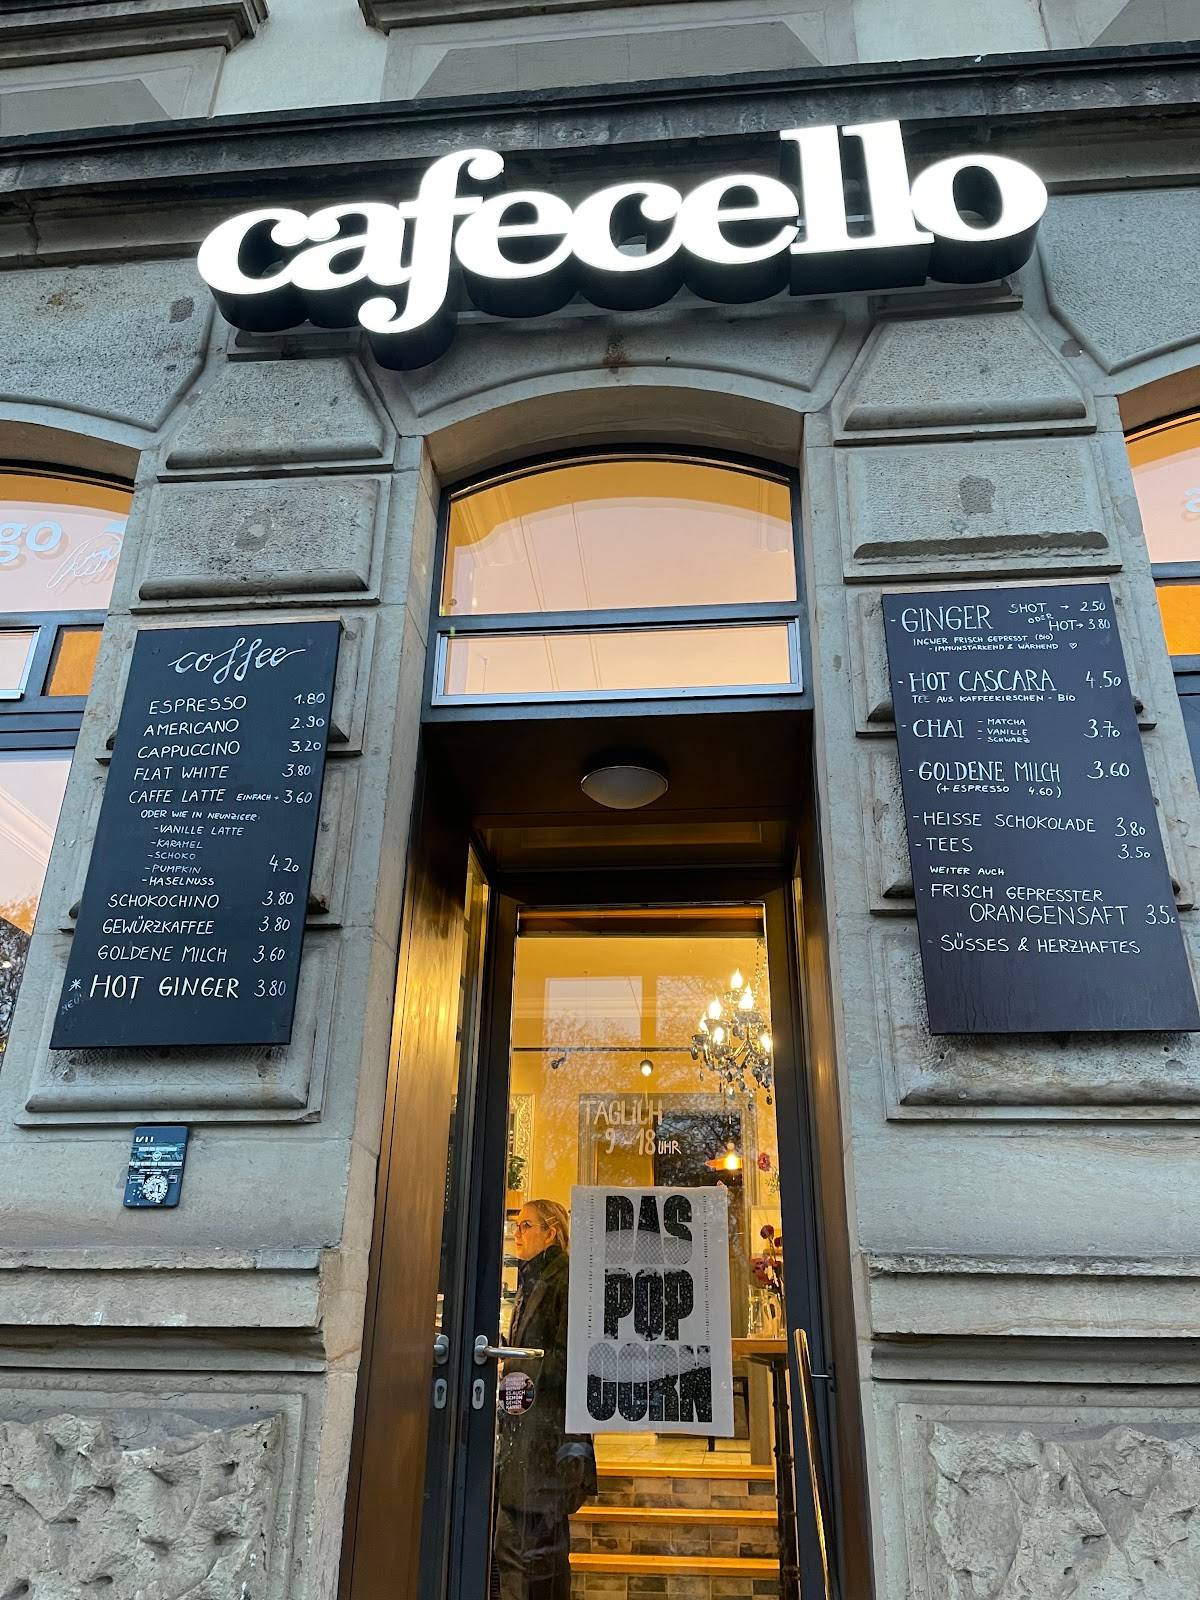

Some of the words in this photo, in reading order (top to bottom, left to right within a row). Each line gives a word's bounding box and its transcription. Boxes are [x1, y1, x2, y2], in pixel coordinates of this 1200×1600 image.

[901, 604, 994, 633] GINGER
[1008, 602, 1048, 614] SHOT
[1079, 601, 1106, 612] 2.50
[1028, 613, 1054, 625] ODER
[1049, 619, 1077, 632] HOT
[1088, 618, 1111, 631] 3.80
[913, 636, 951, 646] INGWER
[954, 636, 983, 644] FRISCH
[987, 635, 1028, 643] GEPRESST
[168, 637, 306, 684] coffee
[909, 671, 950, 692] HOT
[958, 669, 1057, 692] CASCARA
[1085, 670, 1122, 689] 4.50
[149, 695, 247, 715] ESPRESSO
[293, 692, 325, 704] 1.80
[936, 695, 954, 703] AUS
[959, 694, 1044, 702] KAFFEEKIRSCHEN
[143, 719, 240, 737] AMERICANO
[290, 715, 325, 730] 2.90
[912, 719, 964, 738] CHAI
[1084, 719, 1121, 738] 3.70
[987, 718, 1025, 726] MATCHA
[987, 728, 1028, 736] VANILLE
[137, 740, 240, 759] CAPPUCCINO
[288, 740, 322, 753] 3.20
[133, 767, 173, 781] FLAT
[181, 765, 229, 779] WHITE
[281, 763, 312, 777] 3.80
[918, 762, 1004, 782] GOLDENE
[1014, 762, 1060, 782] MILCH
[1087, 761, 1130, 779] 3.60
[181, 788, 226, 802] LATTE
[235, 793, 271, 802] EINFACH
[283, 789, 312, 803] 3.60
[953, 784, 1010, 793] ESPRESSO
[140, 809, 167, 818] ODER
[211, 827, 244, 836] LATTE
[922, 812, 982, 827] HEISSE
[994, 814, 1096, 833] SCHOKOLADE
[1114, 817, 1146, 836] 3.80
[926, 837, 973, 852] TEES
[1118, 844, 1151, 859] 3.50
[269, 854, 300, 873] 4.20
[929, 866, 970, 875] WEITER
[107, 894, 220, 909] SCHOKOCHINO
[262, 891, 294, 905] 3.80
[931, 883, 993, 899] FRISCH
[1006, 886, 1104, 902] GEPRESSTER
[969, 903, 1129, 926] ORANGENSAFT
[102, 915, 214, 935] GEWÜRZKAFFEE
[258, 916, 291, 931] 3.80
[941, 932, 1009, 953] SÜSSES
[1018, 937, 1029, 951] &
[1037, 938, 1141, 955] HERZHAFTES
[97, 946, 173, 963] GOLDENE
[181, 947, 227, 963] MILCH
[252, 945, 285, 963] 3.60
[89, 974, 144, 1000] HOT
[158, 977, 240, 999] GINGER
[254, 980, 286, 997] 3.80
[636, 1127, 656, 1155] 18
[657, 1140, 681, 1154] UHR
[605, 1195, 692, 1264] DAS
[604, 1266, 694, 1341] POP
